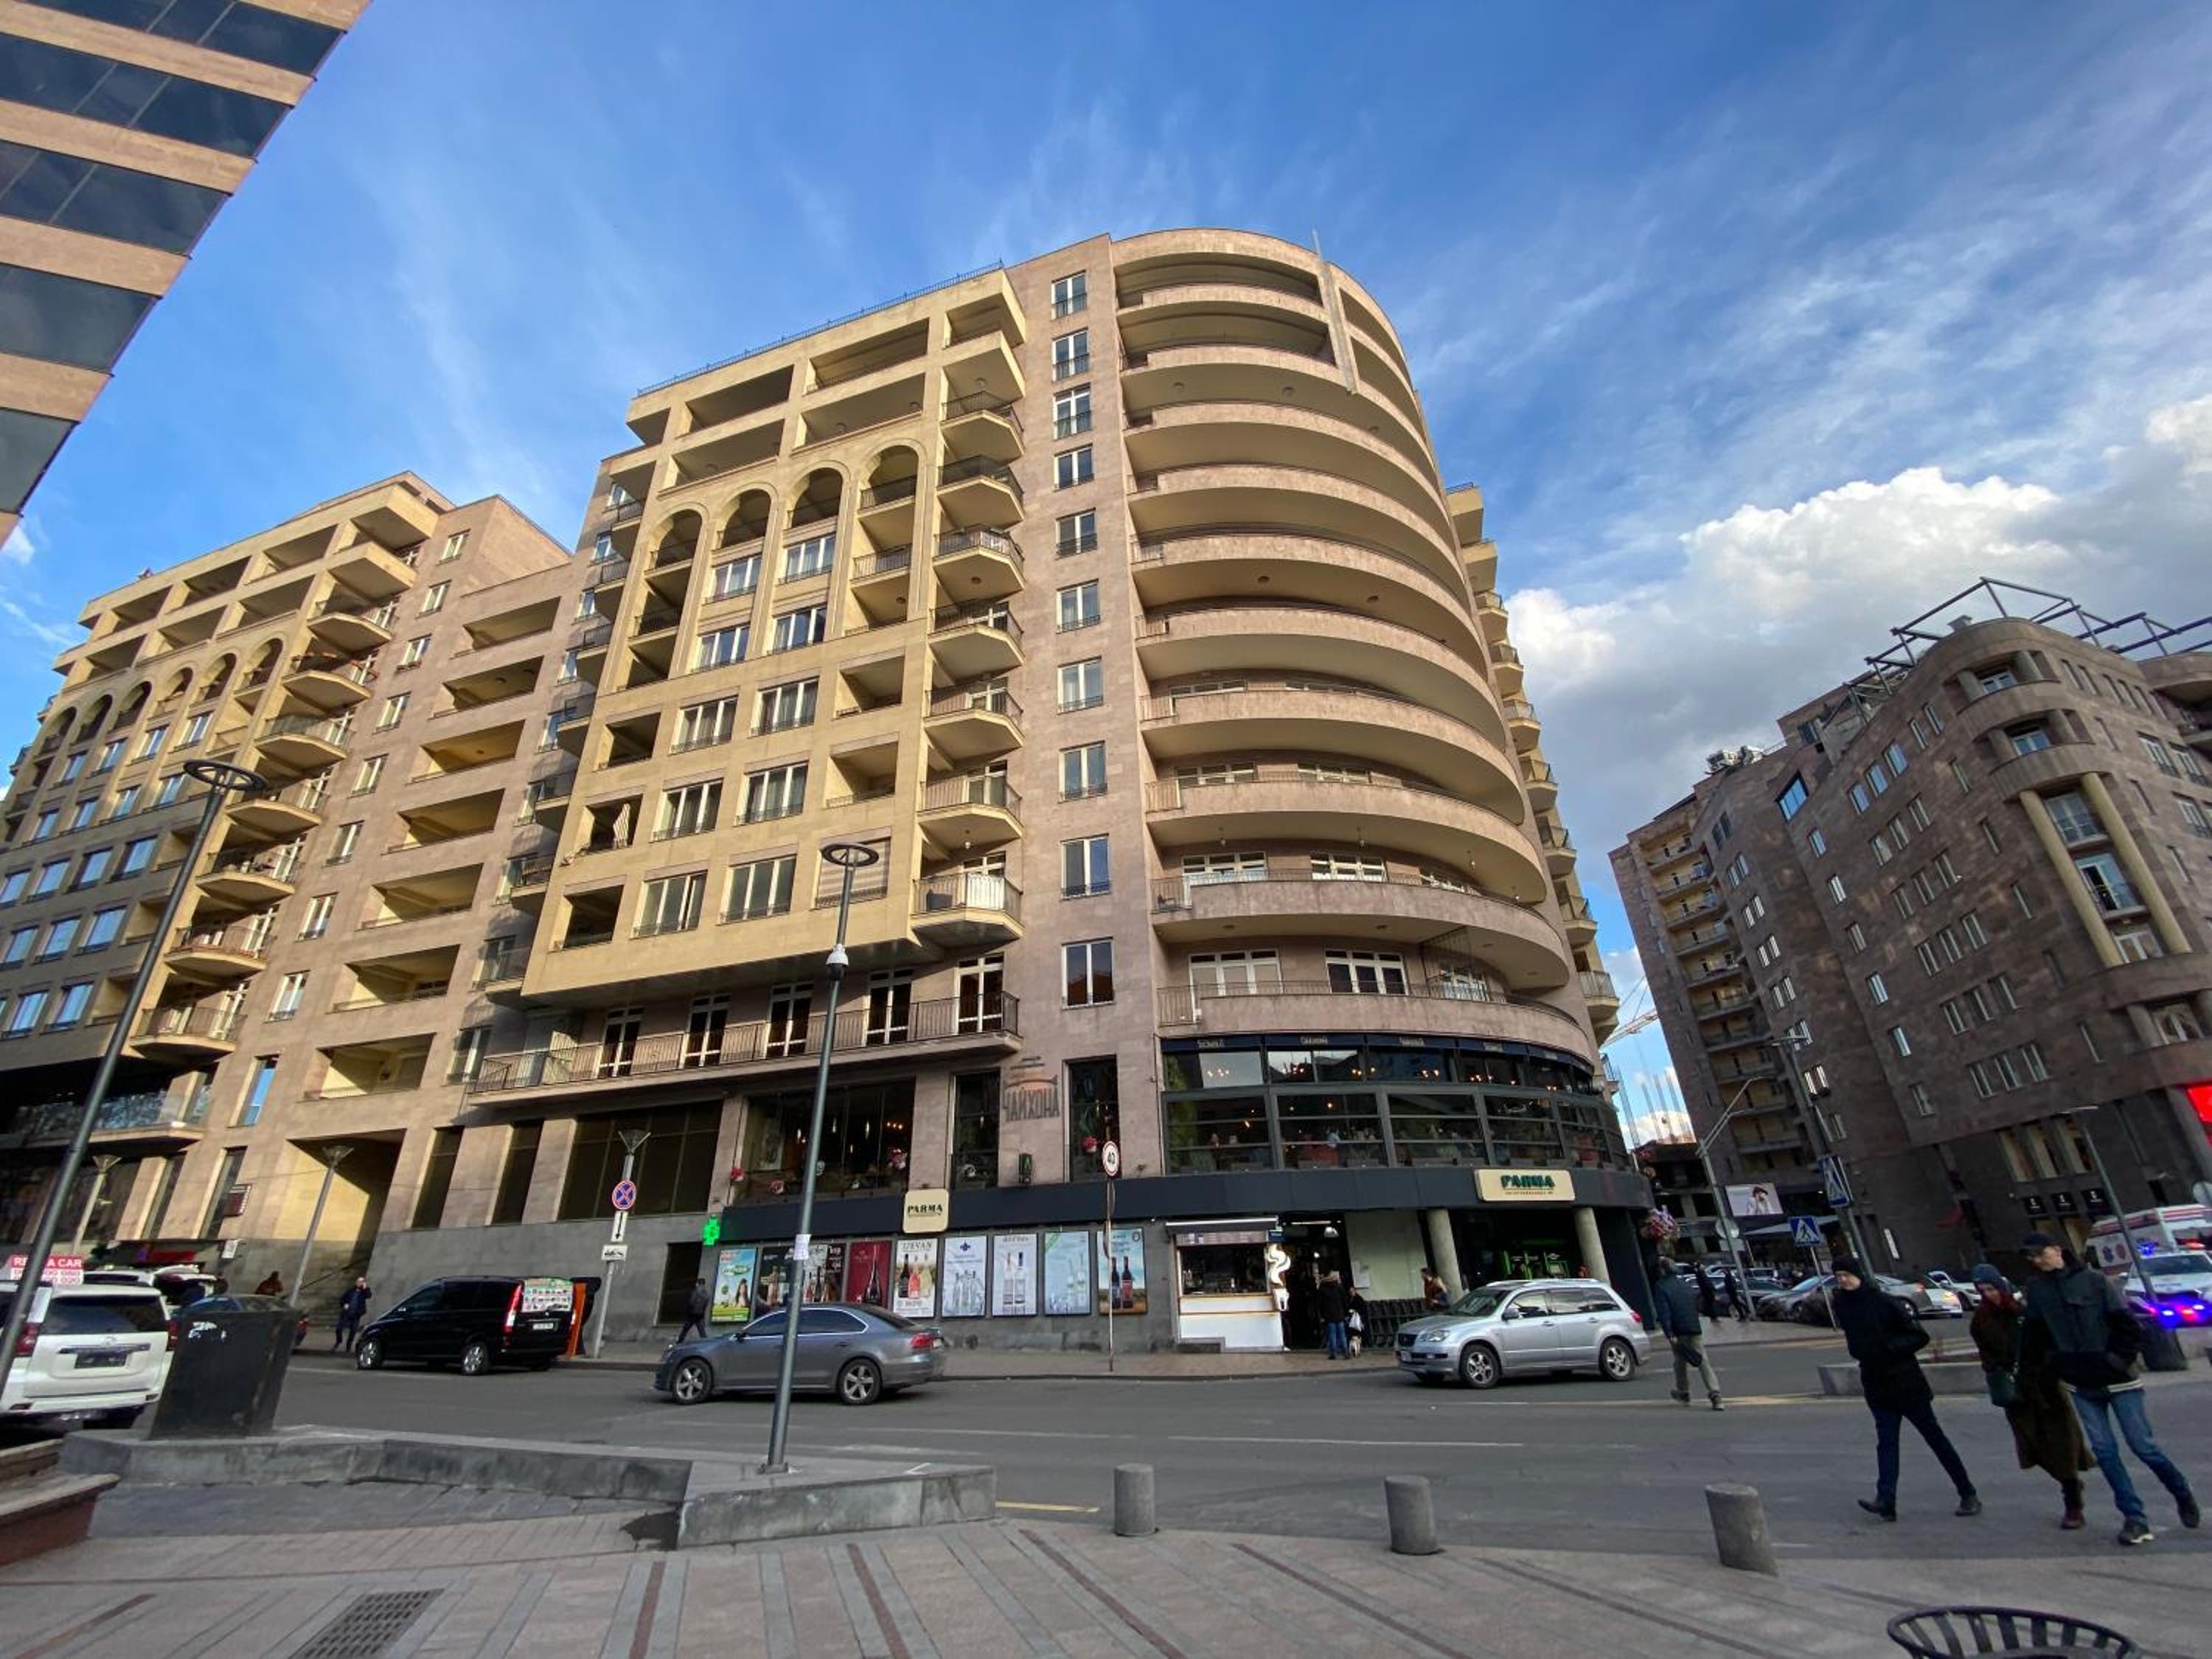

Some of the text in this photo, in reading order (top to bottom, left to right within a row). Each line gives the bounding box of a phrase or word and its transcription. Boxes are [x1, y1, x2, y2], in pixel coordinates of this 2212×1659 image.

[1003, 1087, 1060, 1121] ЧАЙХОНА
[1107, 1152, 1115, 1164] 40
[1500, 1175, 1554, 1189] PARMA
[908, 1204, 942, 1213] PARMA
[58, 1259, 82, 1267] CAR
